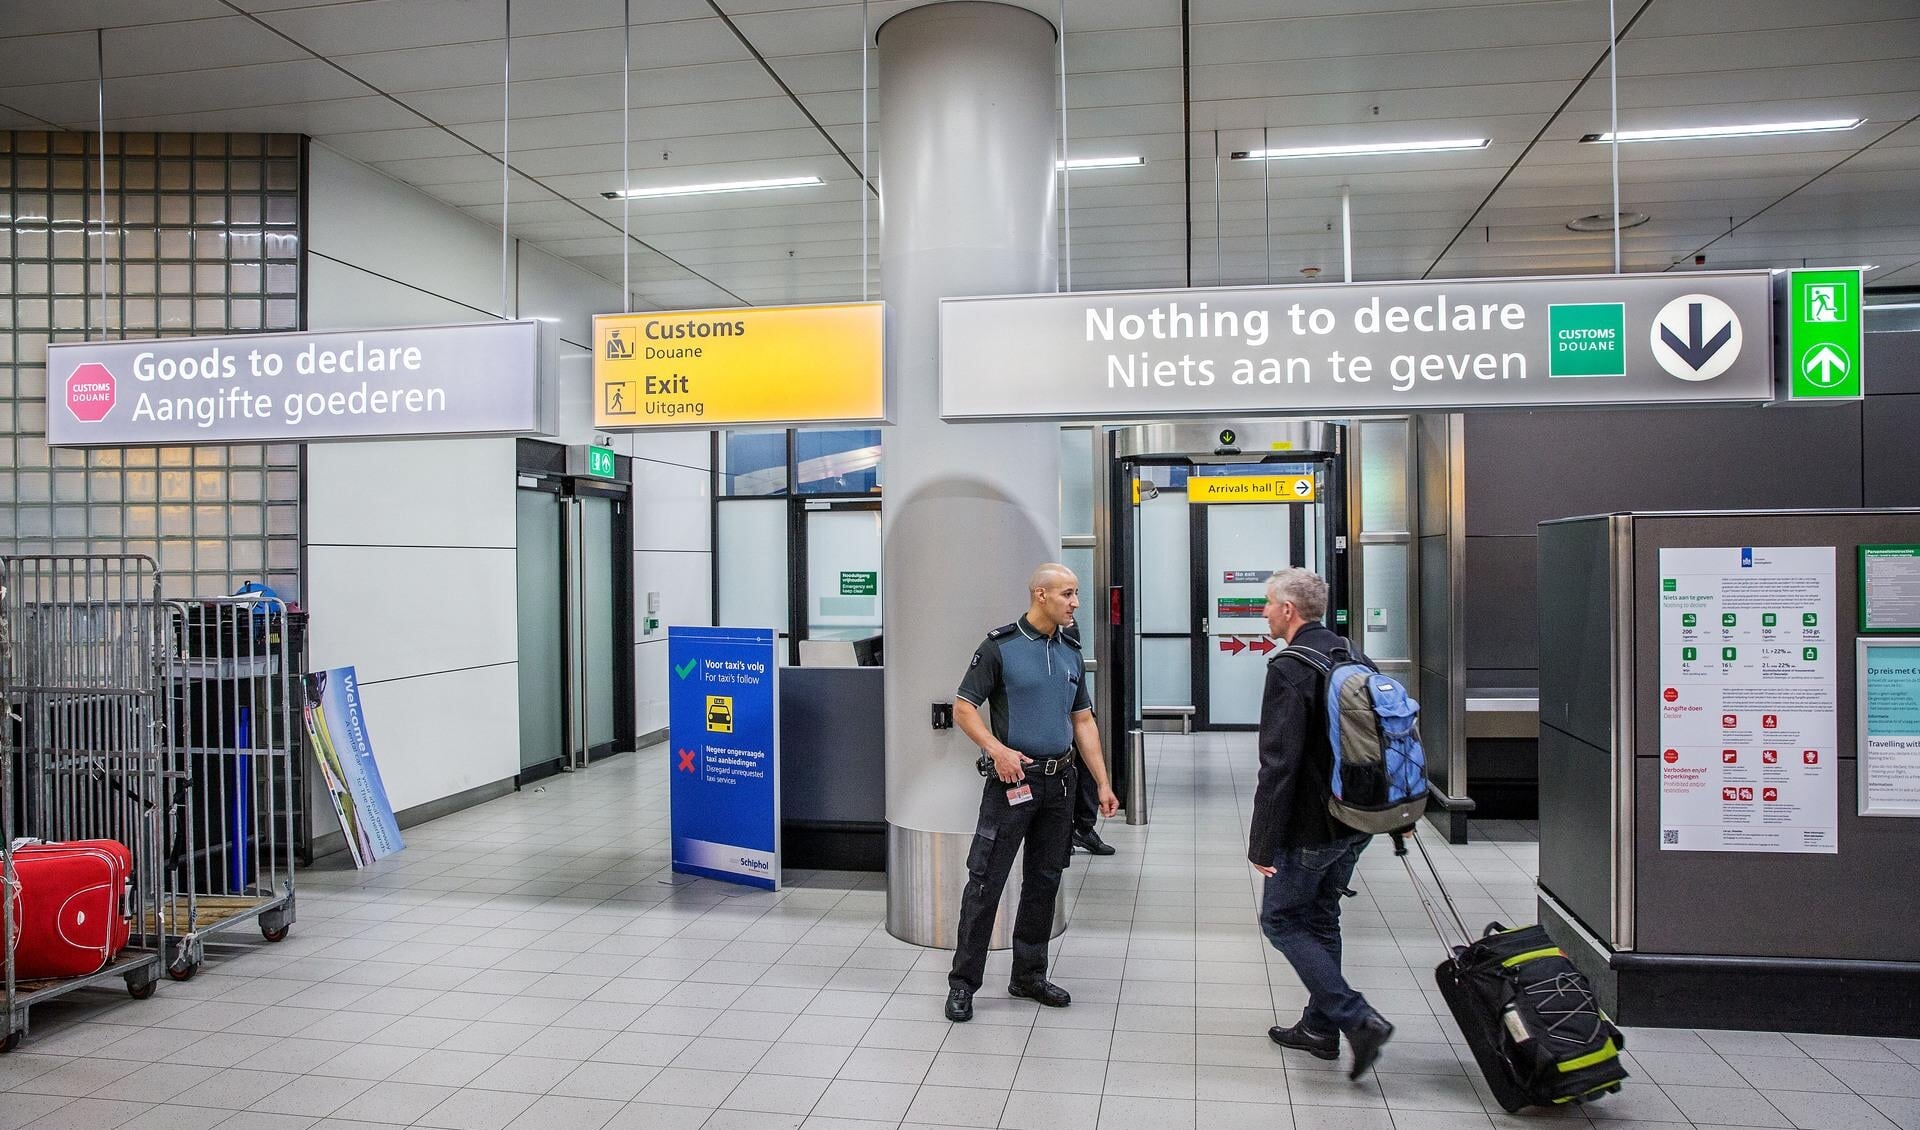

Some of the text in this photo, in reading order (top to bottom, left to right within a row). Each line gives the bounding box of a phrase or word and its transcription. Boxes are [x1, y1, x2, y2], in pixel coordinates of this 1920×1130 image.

[1085, 295, 1527, 346] Nothing to declare
[645, 320, 745, 340] Customs
[1557, 328, 1616, 341] CUSTOMS
[645, 347, 702, 360] Douane
[1557, 341, 1616, 353] DOUANE
[133, 340, 421, 382] Goods to declare
[1108, 352, 1529, 393] Niets aan te geven
[72, 382, 110, 393] CUSTOMS
[645, 373, 689, 395] Exit
[72, 392, 110, 402] DOUANE
[132, 382, 446, 428] Aangifte goederen
[645, 400, 704, 417] Uitgang
[1208, 483, 1272, 493] Arrivals hall
[705, 659, 764, 673] Voor taxi's volg
[1867, 667, 1879, 675] Op
[705, 673, 759, 684] For taxi's follow
[344, 674, 370, 758] Welcome!
[1868, 740, 1905, 749] Travelling
[706, 745, 765, 759] Negeer ongevraagde
[718, 757, 757, 768] aanbiedingen
[706, 765, 764, 779] Disregard unrequested
[716, 777, 736, 785] services
[347, 729, 358, 752] rental
[355, 754, 363, 766] car
[362, 776, 371, 793] your
[369, 795, 379, 815] ideal
[375, 817, 392, 850] gateway
[366, 805, 386, 852] Netherlands
[741, 858, 769, 870] Schiphol
